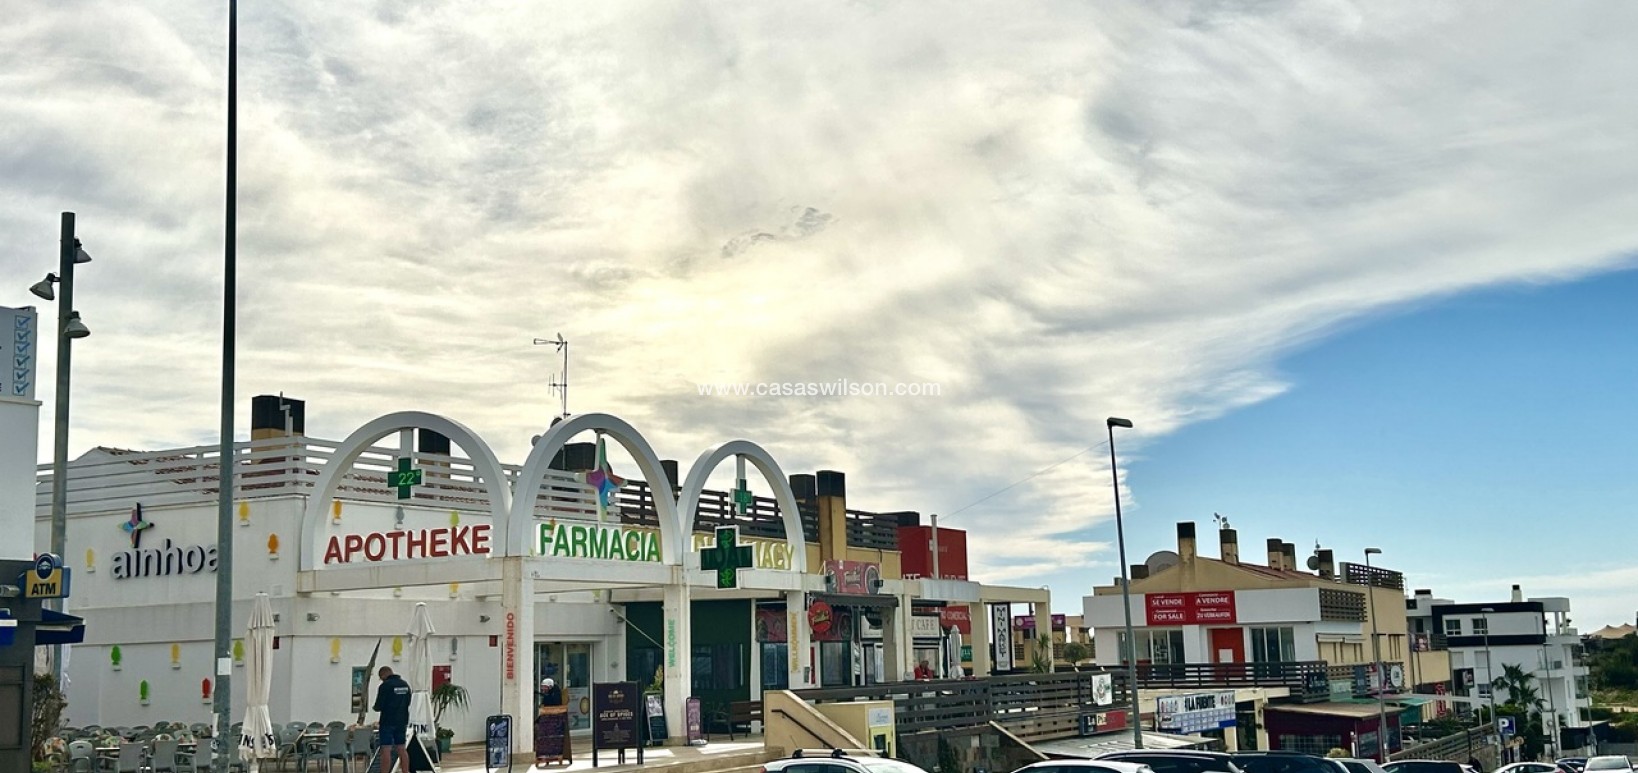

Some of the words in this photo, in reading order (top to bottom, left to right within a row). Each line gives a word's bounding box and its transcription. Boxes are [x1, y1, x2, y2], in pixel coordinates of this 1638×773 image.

[323, 524, 491, 564] APOTHEKE
[539, 522, 662, 562] FARMACIA
[31, 582, 57, 595] ATM
[1152, 598, 1160, 606] SE
[506, 612, 515, 680] BIENVENIDO
[1499, 717, 1509, 733] P
